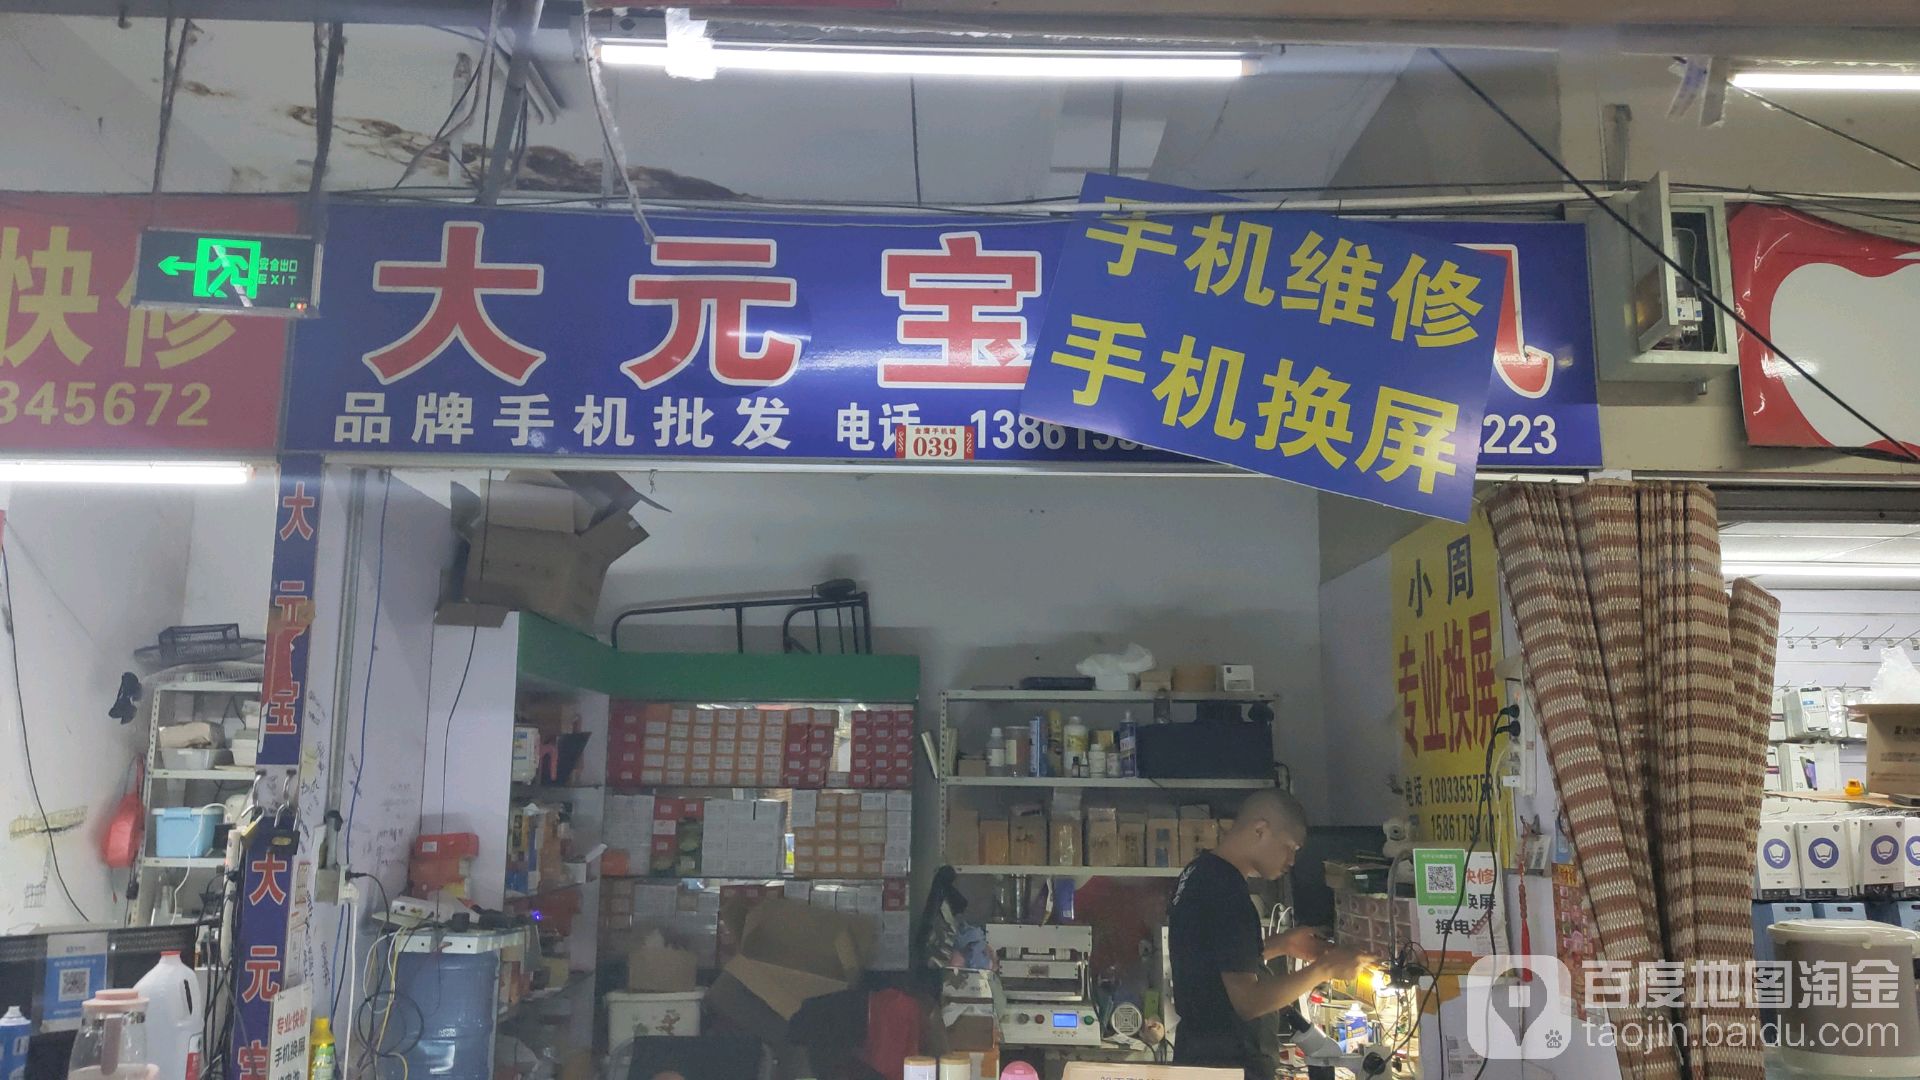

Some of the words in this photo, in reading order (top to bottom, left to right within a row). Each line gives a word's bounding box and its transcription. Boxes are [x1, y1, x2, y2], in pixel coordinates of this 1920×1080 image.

[258, 273, 297, 285] EXIT
[260, 257, 298, 272] 安全出口
[1086, 196, 1485, 348] 手机维修
[334, 392, 791, 450] 品牌手机批发
[837, 402, 920, 451] 电话
[1479, 413, 1557, 455] 223
[1051, 313, 1460, 494] 手机换屏
[913, 436, 957, 457] 039
[1408, 533, 1475, 618] 小周
[1398, 610, 1499, 758] 专业换屏
